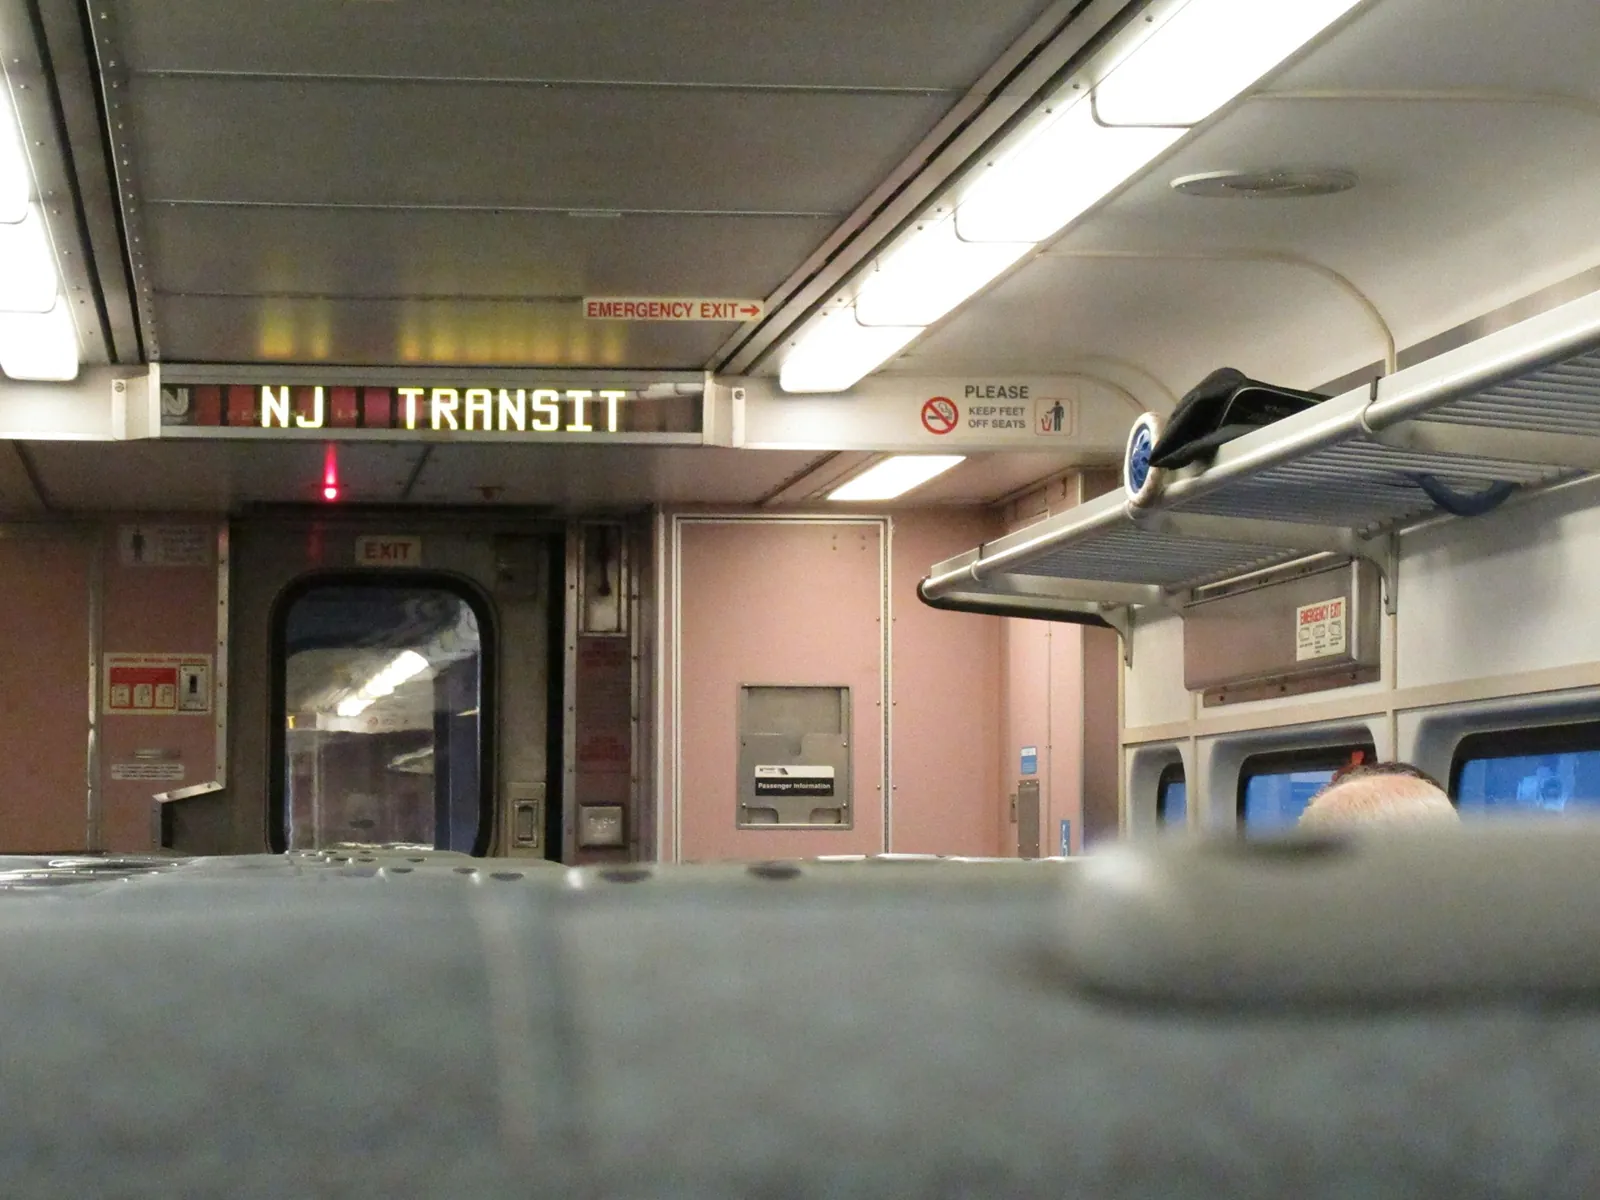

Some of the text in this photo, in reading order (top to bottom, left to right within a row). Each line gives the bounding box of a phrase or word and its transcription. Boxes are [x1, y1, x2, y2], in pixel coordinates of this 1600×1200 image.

[587, 302, 738, 318] EMERGENCY EXIT
[964, 385, 1029, 399] PLEASE
[260, 385, 626, 432] NJ TRANSIT
[968, 406, 1026, 416] KEEP FEET
[968, 419, 1026, 429] OFF SEATS
[364, 541, 412, 560] EXIT
[1330, 602, 1341, 618] EXIT
[758, 782, 792, 790] Passenger
